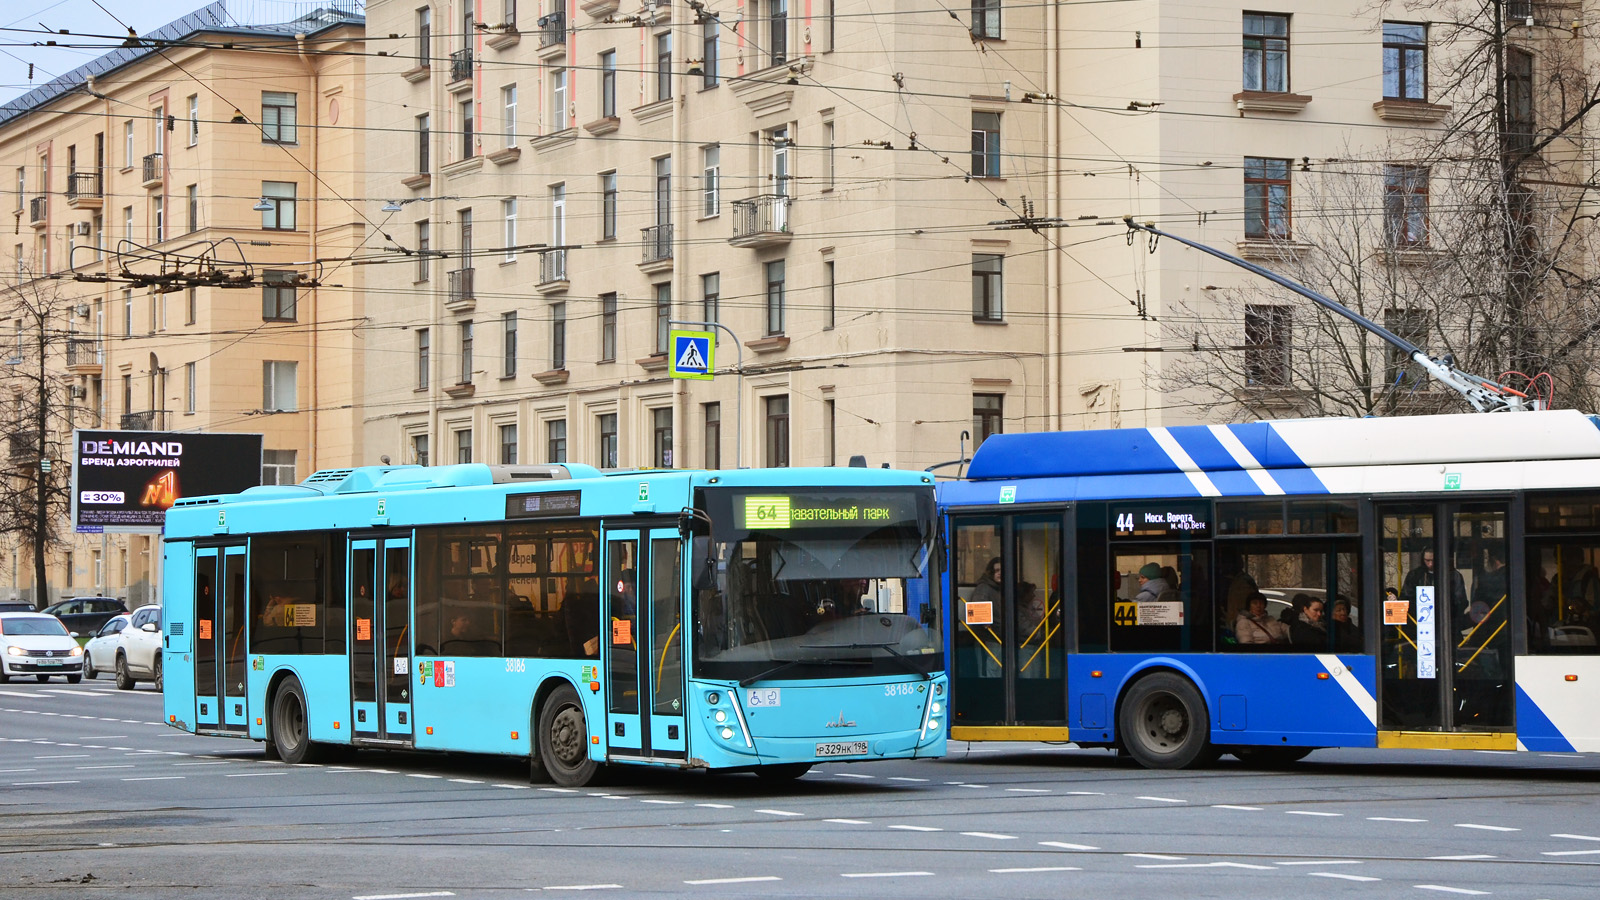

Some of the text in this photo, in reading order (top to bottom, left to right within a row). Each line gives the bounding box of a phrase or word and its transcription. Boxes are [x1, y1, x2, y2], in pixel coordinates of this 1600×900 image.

[81, 457, 180, 467] БРЕНД АЭРОГРИЛЕЙ
[757, 505, 777, 520] 64
[863, 507, 890, 520] парк
[1144, 512, 1193, 523] Моск. Ворота
[1116, 513, 1134, 532] 44
[285, 607, 295, 626] 64
[1115, 605, 1137, 625] 44
[505, 658, 526, 673] 38186
[884, 684, 914, 697] 38186
